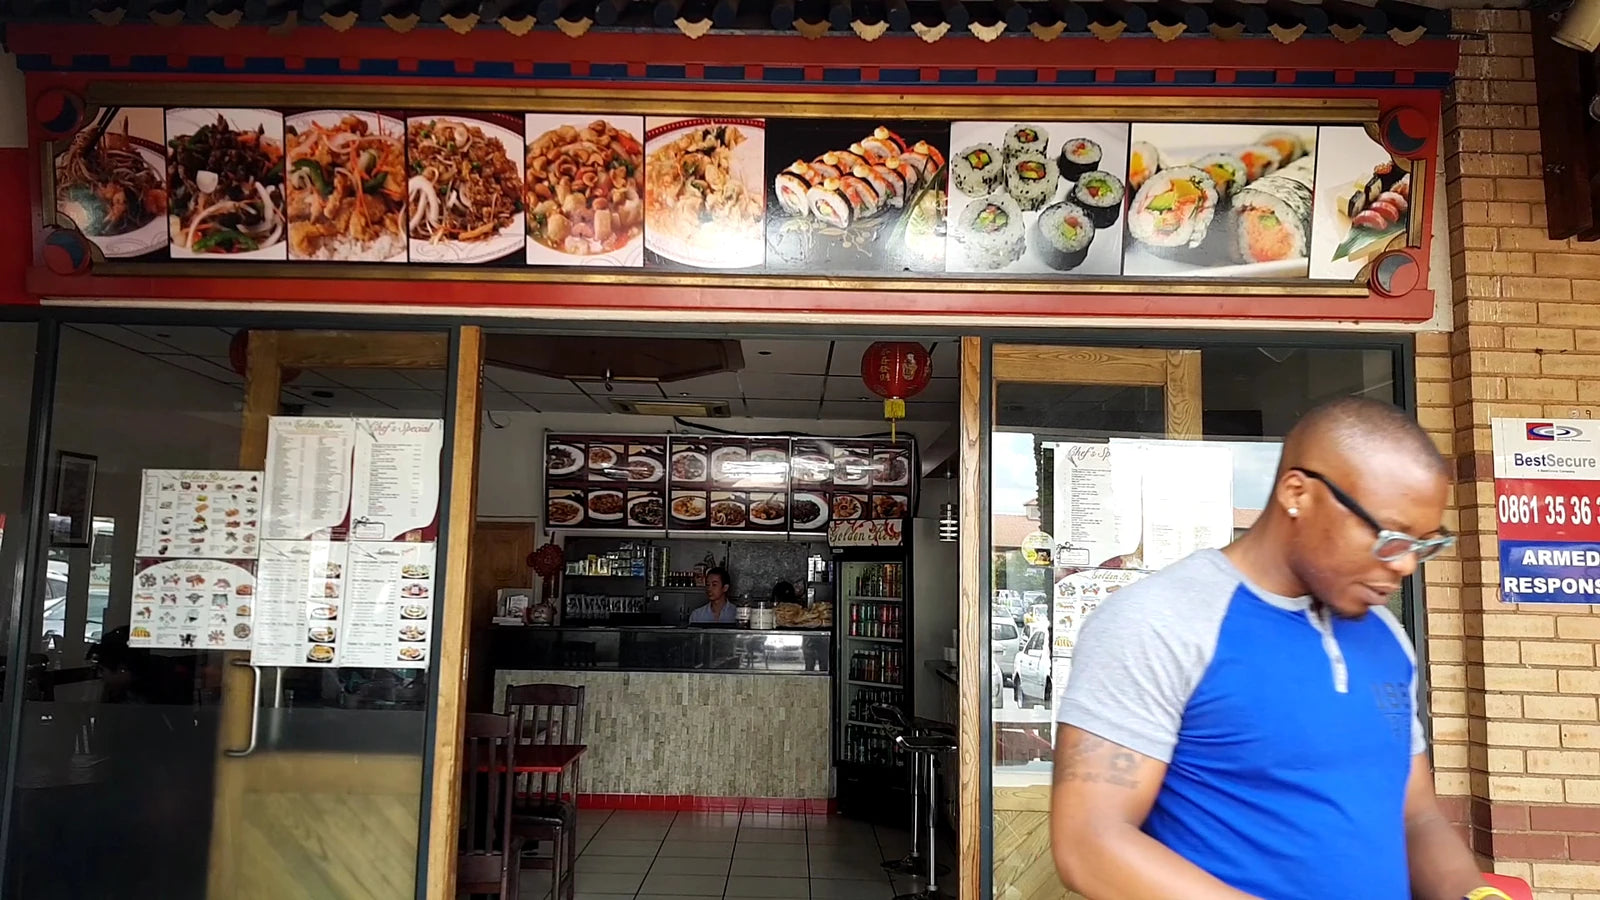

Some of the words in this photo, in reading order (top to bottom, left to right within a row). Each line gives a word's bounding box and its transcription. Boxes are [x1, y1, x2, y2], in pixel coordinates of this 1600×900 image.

[370, 420, 397, 437] Chef's
[397, 422, 434, 437] Special
[1067, 445, 1097, 461] Chef's
[1514, 453, 1596, 467] BestSecure
[1498, 494, 1539, 523] 0861
[1544, 495, 1566, 524] 35
[1570, 496, 1592, 525] 36
[829, 526, 865, 542] Golden
[1521, 549, 1600, 567] ARMED
